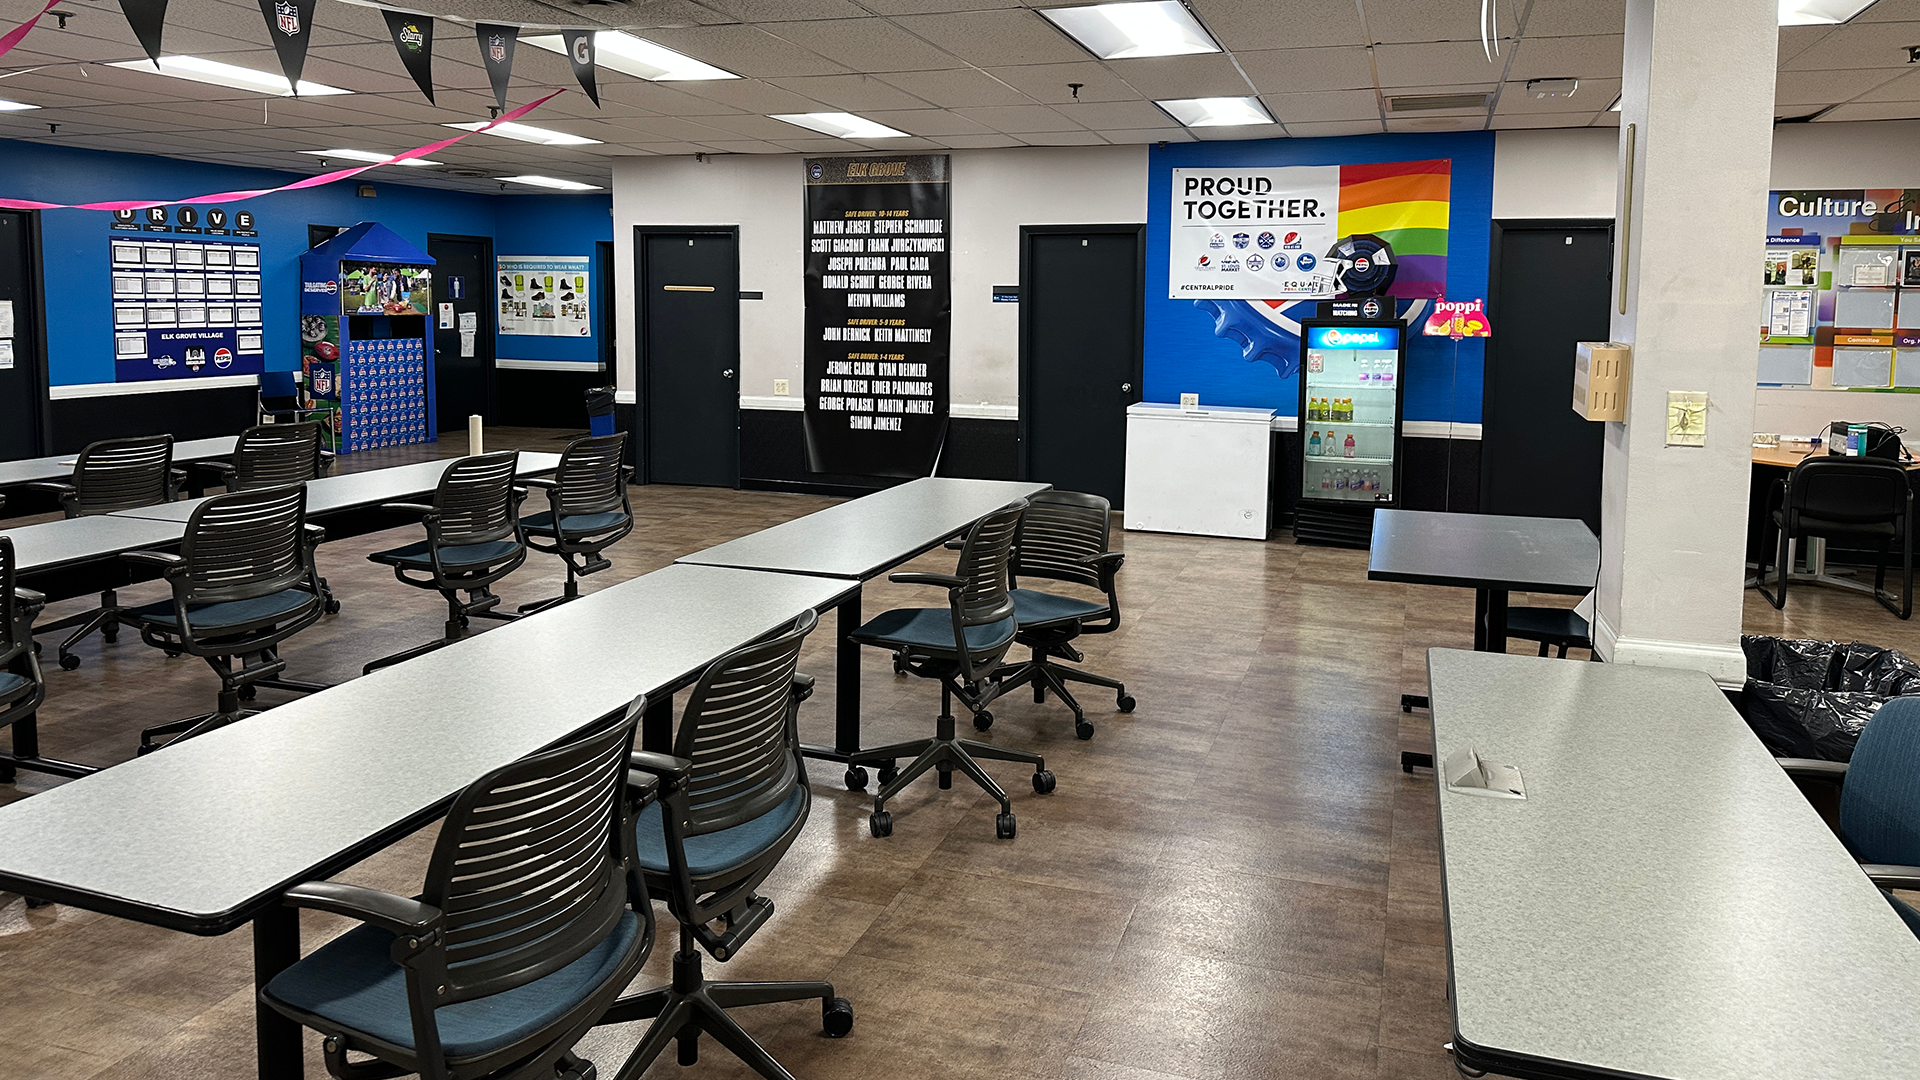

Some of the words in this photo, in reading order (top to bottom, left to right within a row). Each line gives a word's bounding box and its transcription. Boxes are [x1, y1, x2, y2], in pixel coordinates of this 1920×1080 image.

[279, 15, 298, 32] NFL
[400, 26, 423, 46] Starry
[490, 44, 504, 60] NFL
[573, 36, 589, 64] G
[847, 163, 867, 176] ELK
[868, 162, 906, 176] GROVE
[1184, 176, 1272, 196] PROUD
[1183, 198, 1326, 220] TOGETHER.
[1779, 196, 1877, 216] Culture
[813, 220, 844, 234] MATTHEW
[845, 220, 870, 234] JENSEN
[874, 220, 902, 234] STEPHEN
[904, 220, 943, 234] SCHMUDDE
[811, 239, 831, 252] SCOTT
[833, 238, 864, 252] GIACOMO
[868, 238, 889, 252] FRANK
[891, 238, 944, 252] JURCZYKOWSKI
[828, 257, 853, 270] JOSEPH
[854, 257, 886, 270] POREMBA
[890, 257, 908, 270] PAUL
[910, 257, 929, 270] CADA
[823, 276, 848, 289] DONALD
[878, 276, 905, 289] GEORGE
[906, 276, 932, 289] RIVERA
[872, 294, 905, 308] WILLIAMS
[1435, 299, 1481, 314] poppi
[823, 328, 841, 341] JOHN
[843, 328, 870, 342] BERNICK
[874, 328, 893, 342] KEITH
[895, 329, 931, 342] MATTINGLY
[1342, 332, 1379, 345] pepsi
[827, 361, 852, 375] JEROME
[854, 362, 875, 376] CLARK
[878, 363, 897, 376] RYAN
[899, 363, 927, 377] DEIMLER
[315, 380, 329, 391] NFL
[821, 379, 842, 393] BRIAN
[843, 380, 868, 393] ORZECH
[892, 381, 933, 396] PALOMARES
[819, 397, 844, 410] GEORGE
[846, 398, 874, 412] POLASKI
[877, 399, 904, 413] MARTIN
[905, 400, 934, 414] JIMENEZ
[850, 416, 872, 430] SIMON
[874, 417, 902, 431] JIMENEZ
